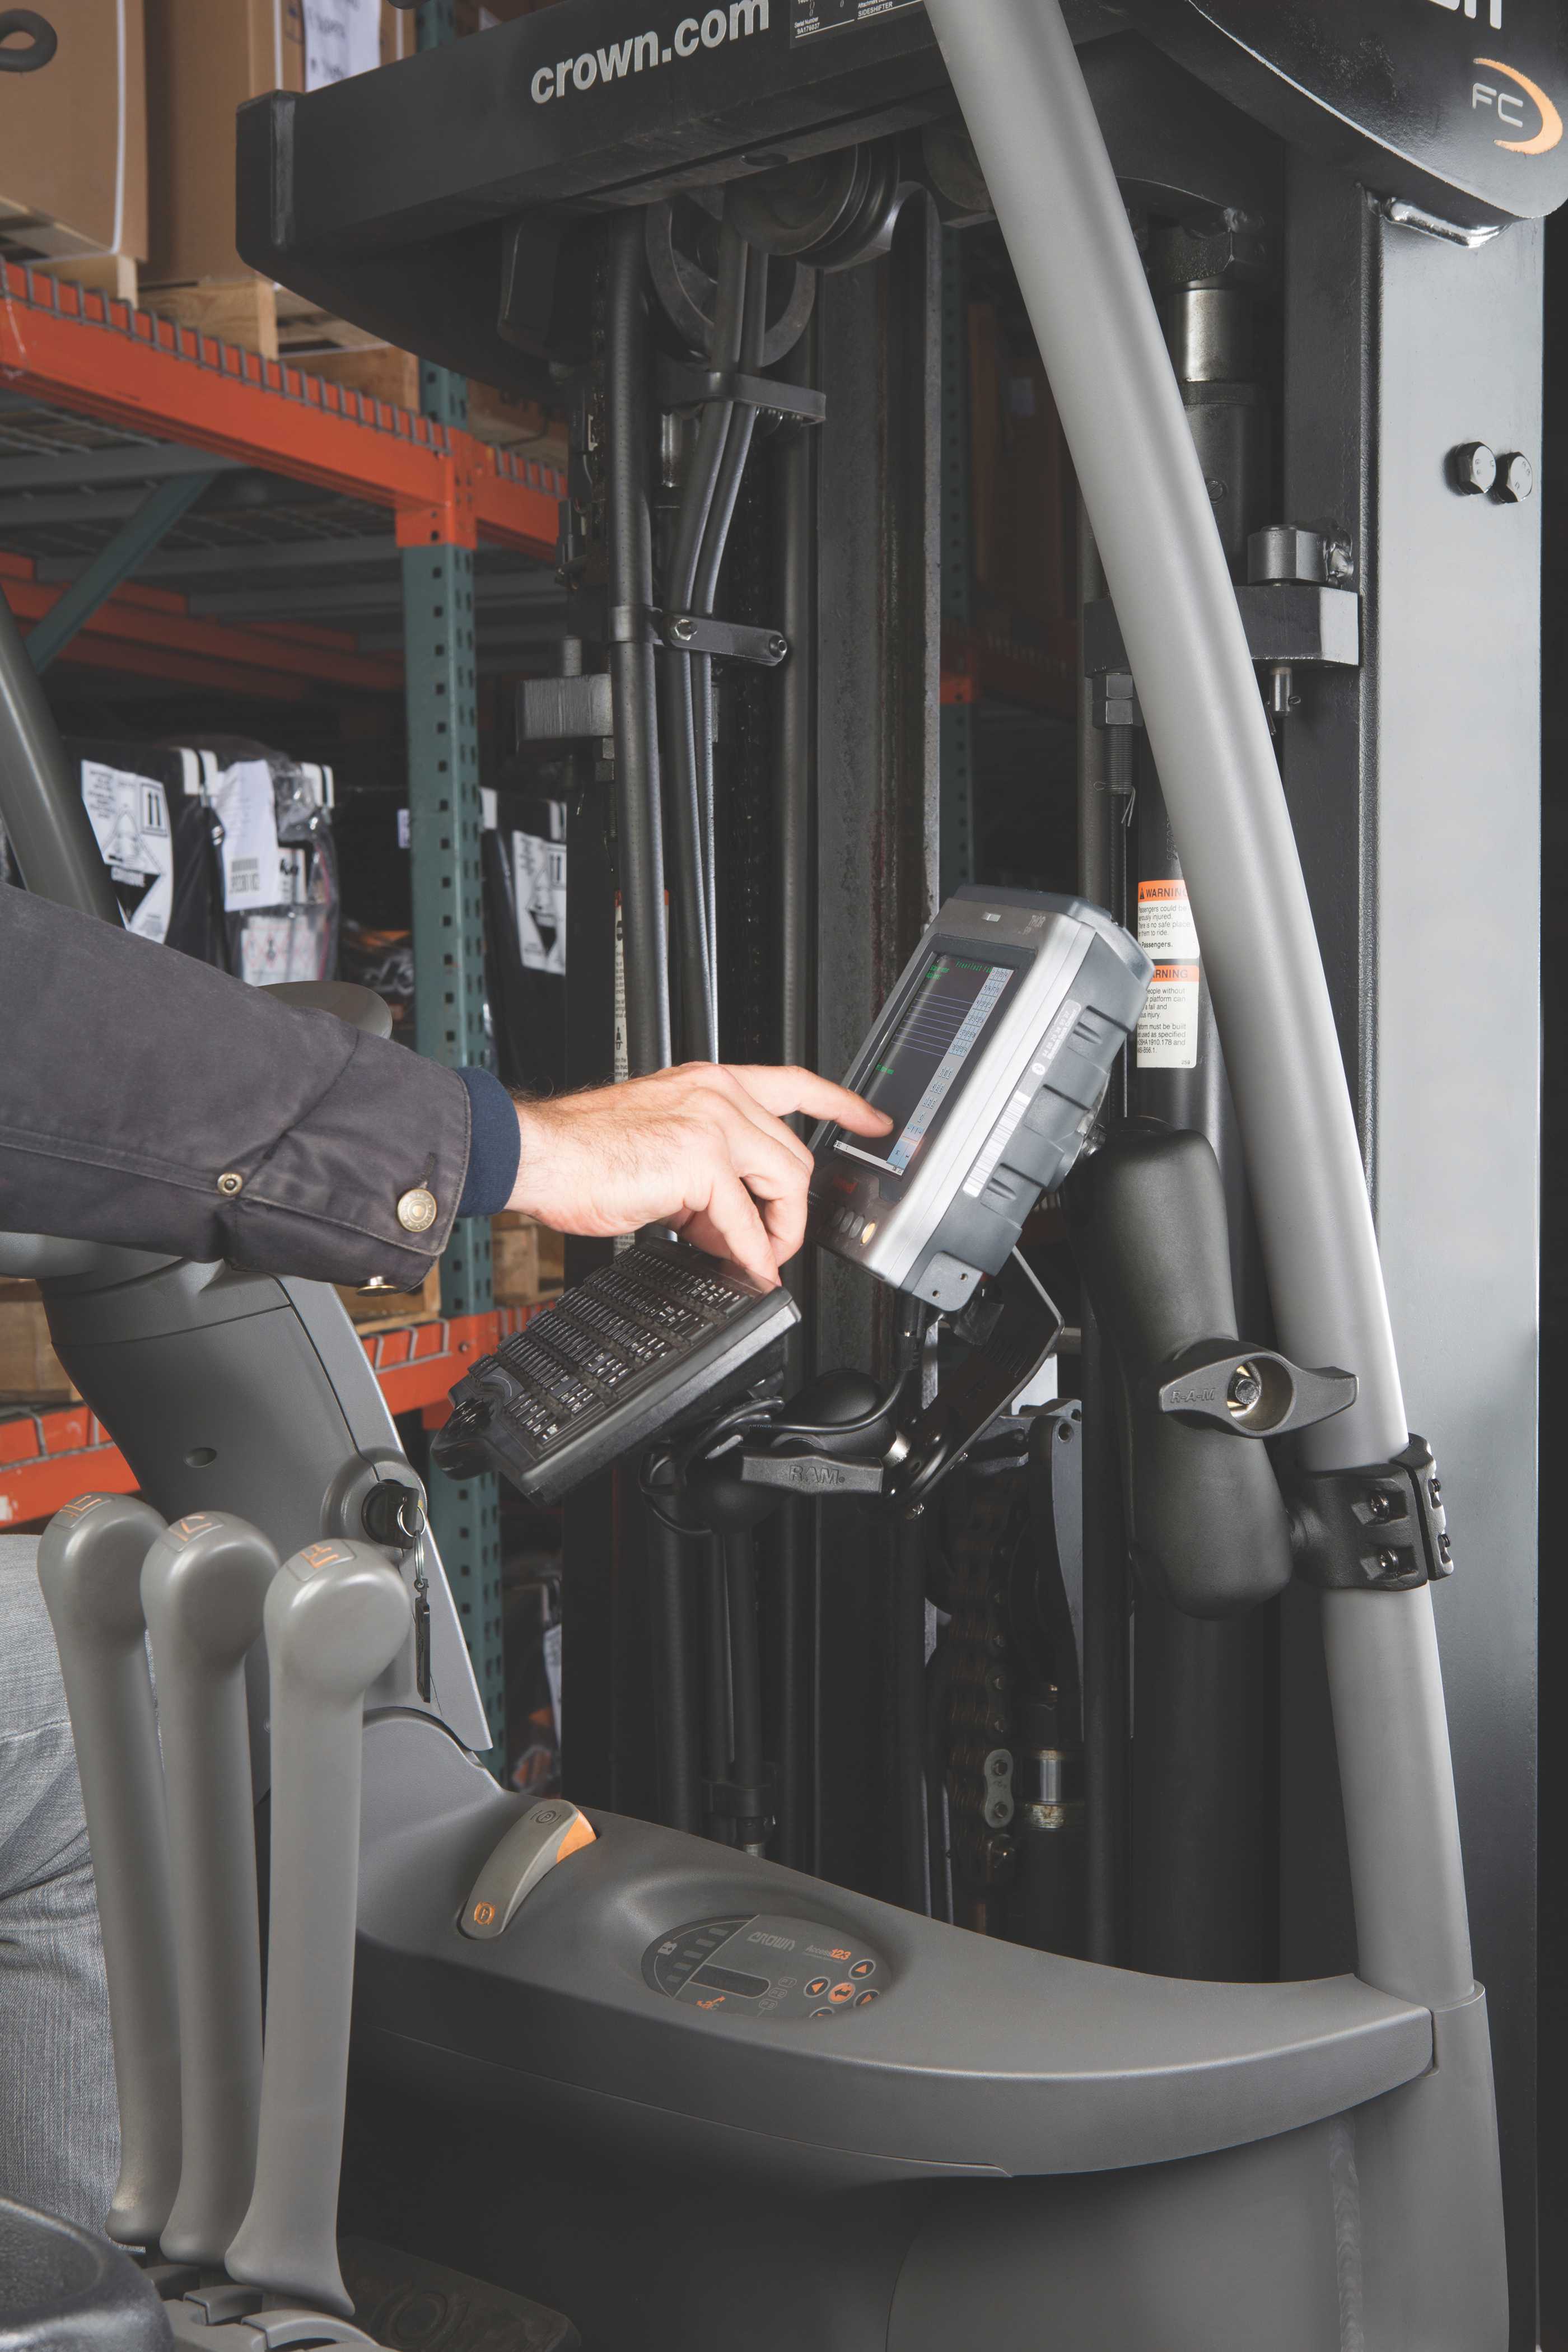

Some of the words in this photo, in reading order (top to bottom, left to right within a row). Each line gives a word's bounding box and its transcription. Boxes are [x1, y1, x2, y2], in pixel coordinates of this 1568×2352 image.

[858, 1, 893, 17] SIDESHIFTER
[794, 20, 805, 28] Serial
[805, 17, 819, 25] Number
[531, 0, 769, 105] crown.com
[1473, 83, 1523, 128] FC
[1152, 969, 1188, 978] RNING
[1158, 1031, 1186, 1039] specified
[1170, 1387, 1215, 1403] R-A-M
